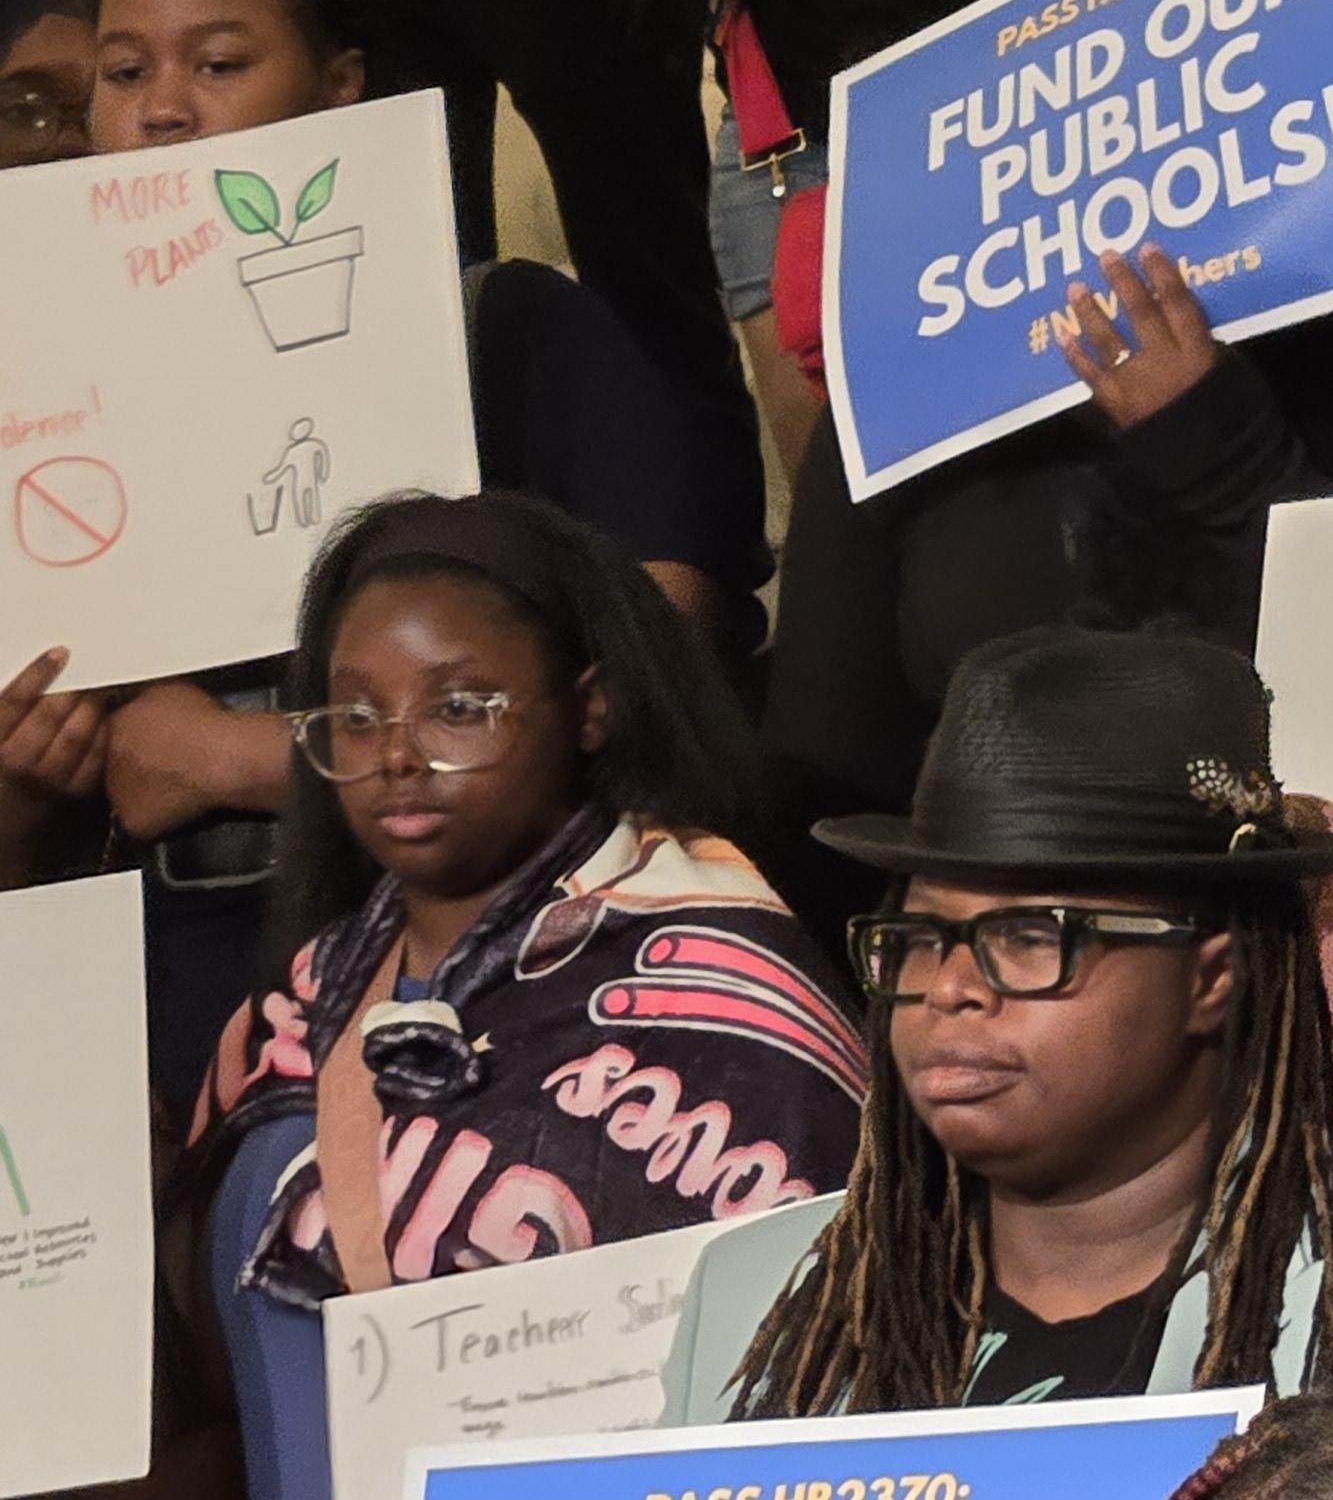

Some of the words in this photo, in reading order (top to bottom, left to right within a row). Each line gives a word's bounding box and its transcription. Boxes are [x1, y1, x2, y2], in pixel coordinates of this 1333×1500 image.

[995, 0, 1082, 57] PASS
[925, 29, 1126, 173] FUND
[979, 31, 1266, 225] PUBLIC
[88, 168, 194, 226] MORE
